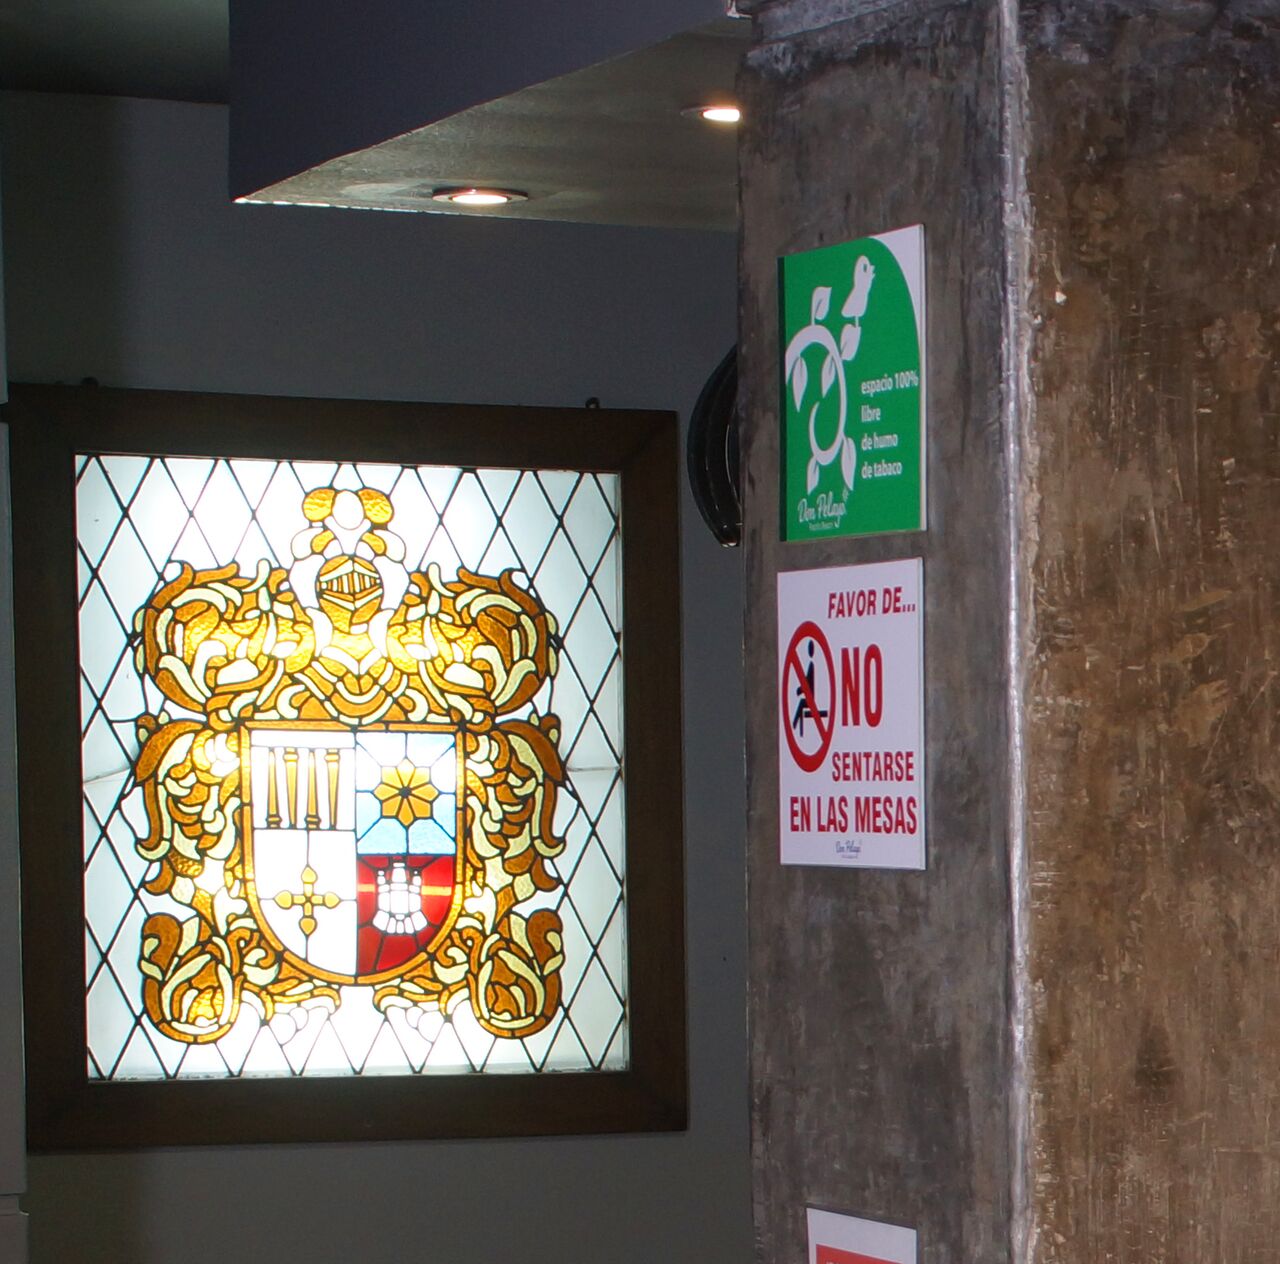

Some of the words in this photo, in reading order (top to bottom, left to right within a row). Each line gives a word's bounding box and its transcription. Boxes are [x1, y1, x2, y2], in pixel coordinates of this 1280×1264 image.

[861, 373, 893, 397] espacio
[894, 369, 919, 389] 100%
[861, 405, 881, 422] libre
[861, 433, 872, 451] de
[873, 432, 898, 449] humo
[861, 461, 872, 479] de
[873, 459, 903, 477] tabaco
[827, 588, 877, 619] FAVOR
[881, 586, 916, 615] DE...
[840, 643, 883, 728] NO
[831, 751, 914, 783] SENTARSE
[790, 796, 811, 833] EN
[816, 796, 848, 833] LAS
[854, 796, 917, 836] MESAS
